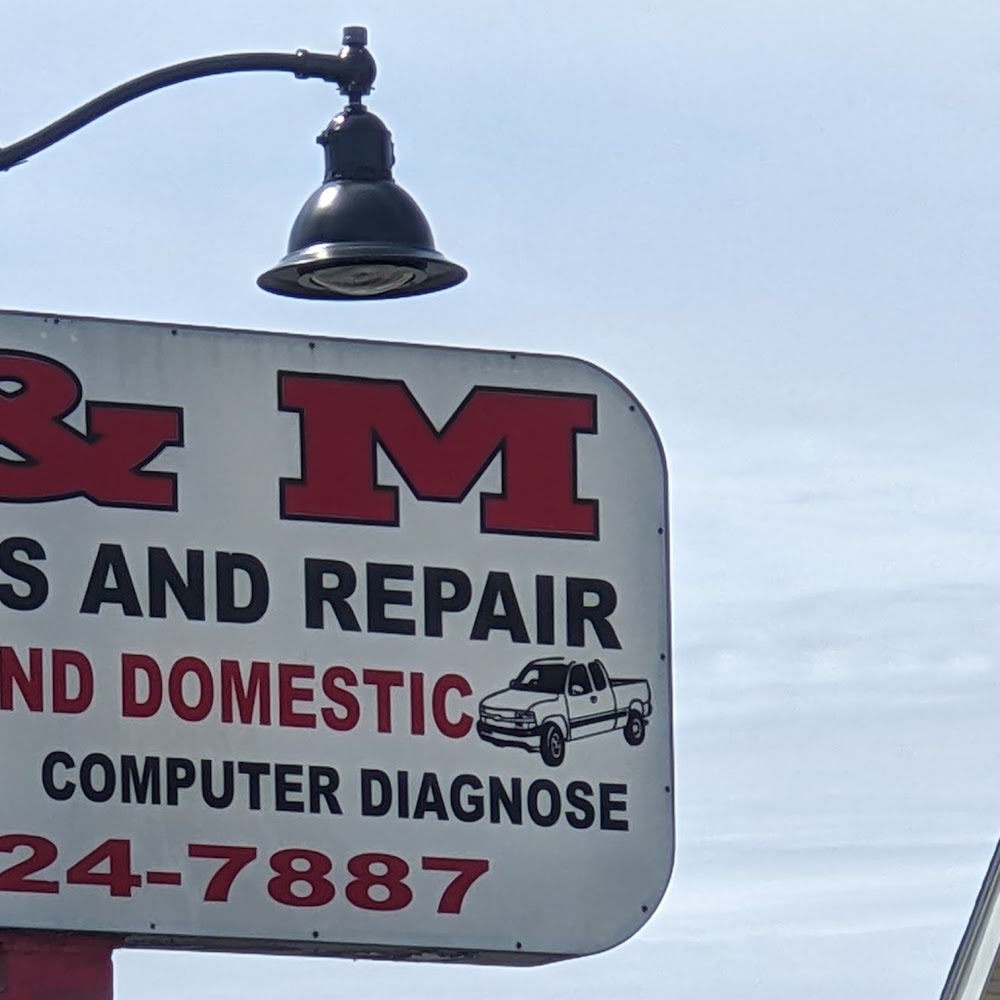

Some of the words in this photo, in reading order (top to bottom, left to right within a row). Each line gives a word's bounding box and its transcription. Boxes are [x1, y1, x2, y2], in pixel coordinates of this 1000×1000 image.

[277, 369, 600, 541] M
[80, 543, 270, 625] AND
[304, 557, 622, 650] REPAIR
[120, 652, 475, 740] DOMESTIC
[41, 750, 344, 817] COMPUTER
[360, 768, 630, 832] DIAGNOSE
